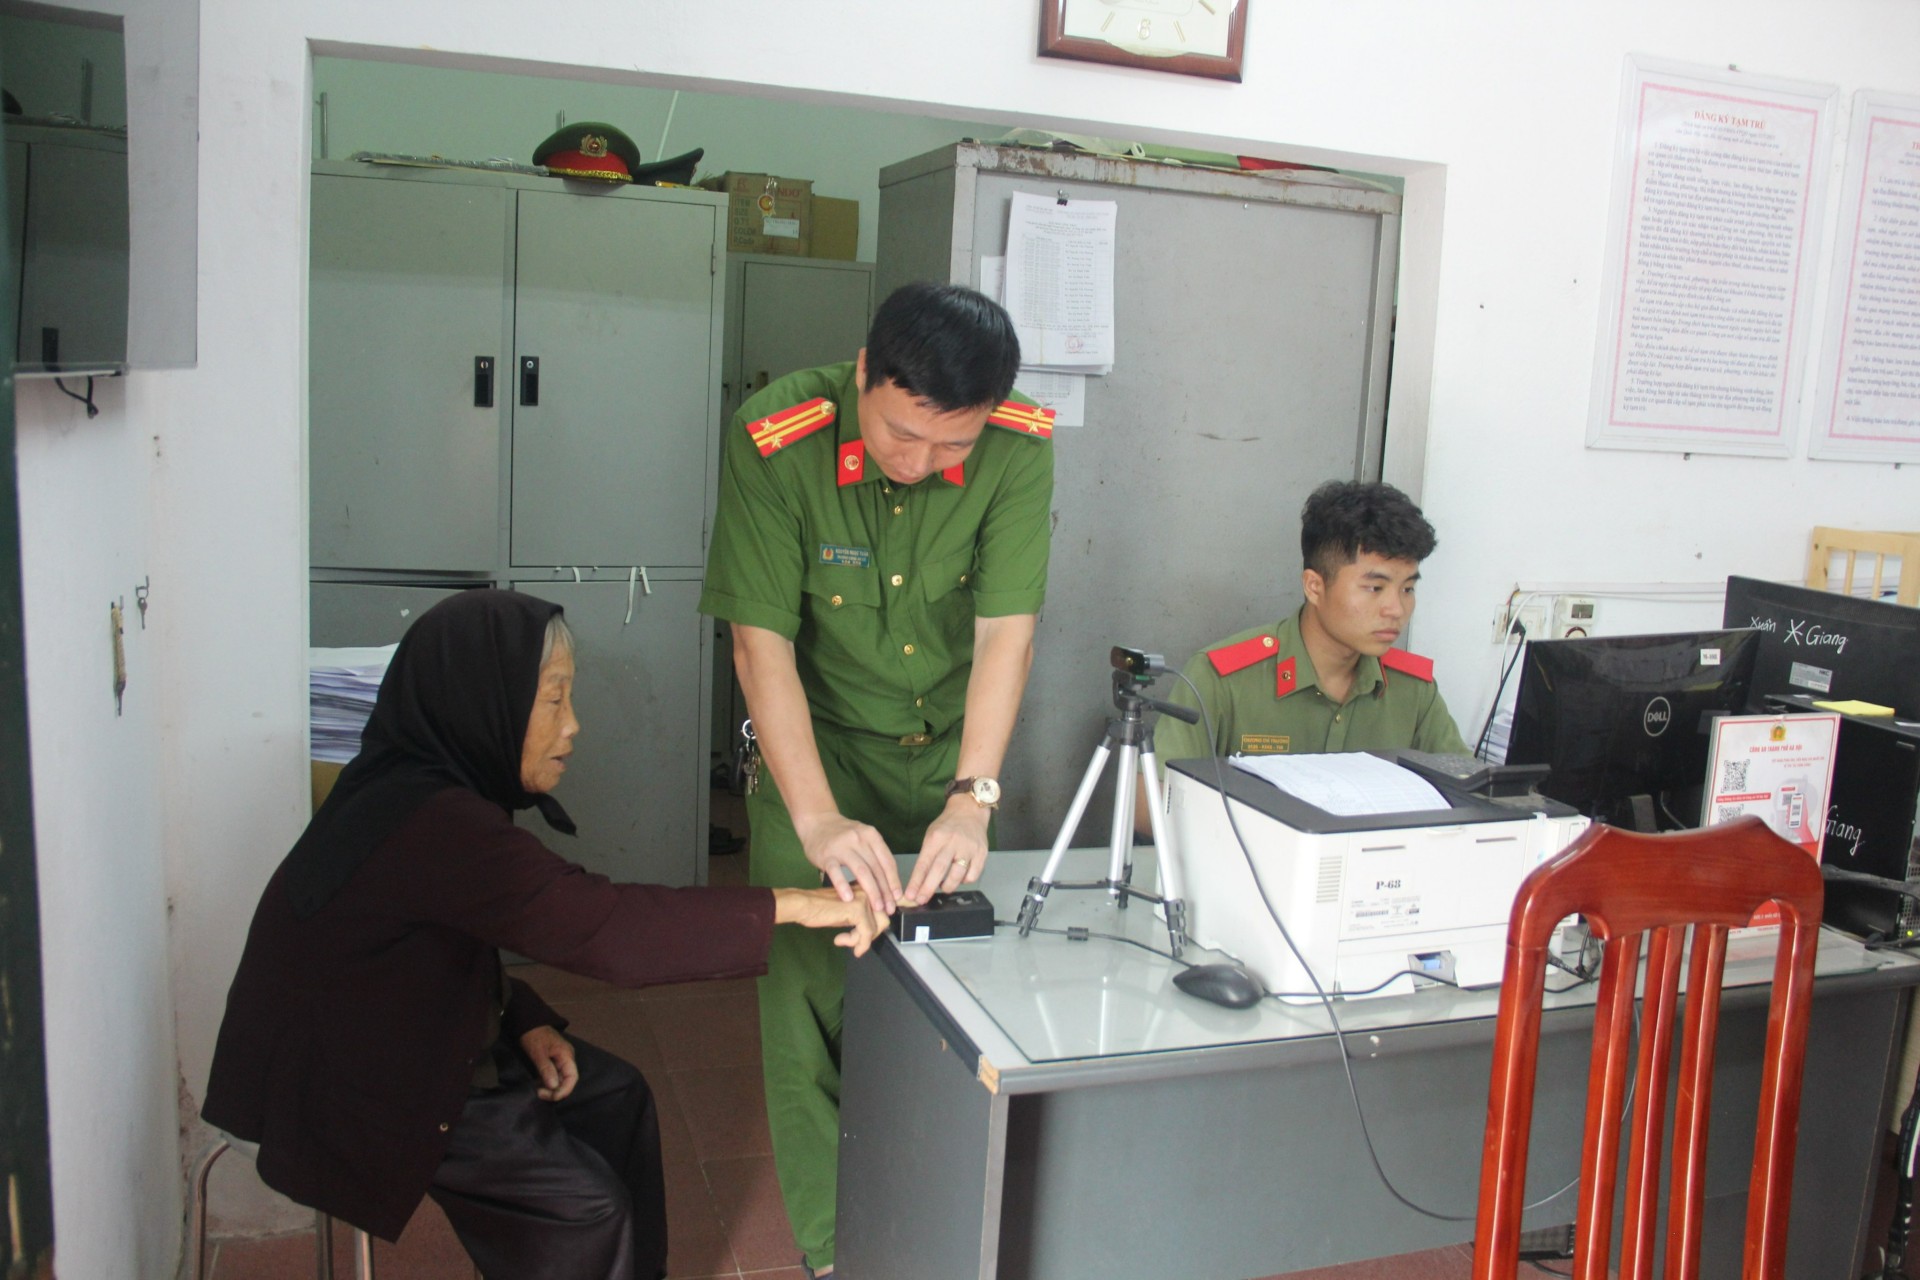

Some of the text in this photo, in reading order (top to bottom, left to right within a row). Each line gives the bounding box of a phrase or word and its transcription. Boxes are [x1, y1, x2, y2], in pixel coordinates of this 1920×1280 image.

[1718, 111, 1730, 124] KÝ
[1806, 625, 1848, 654] Giang
[1647, 711, 1668, 723] DELL
